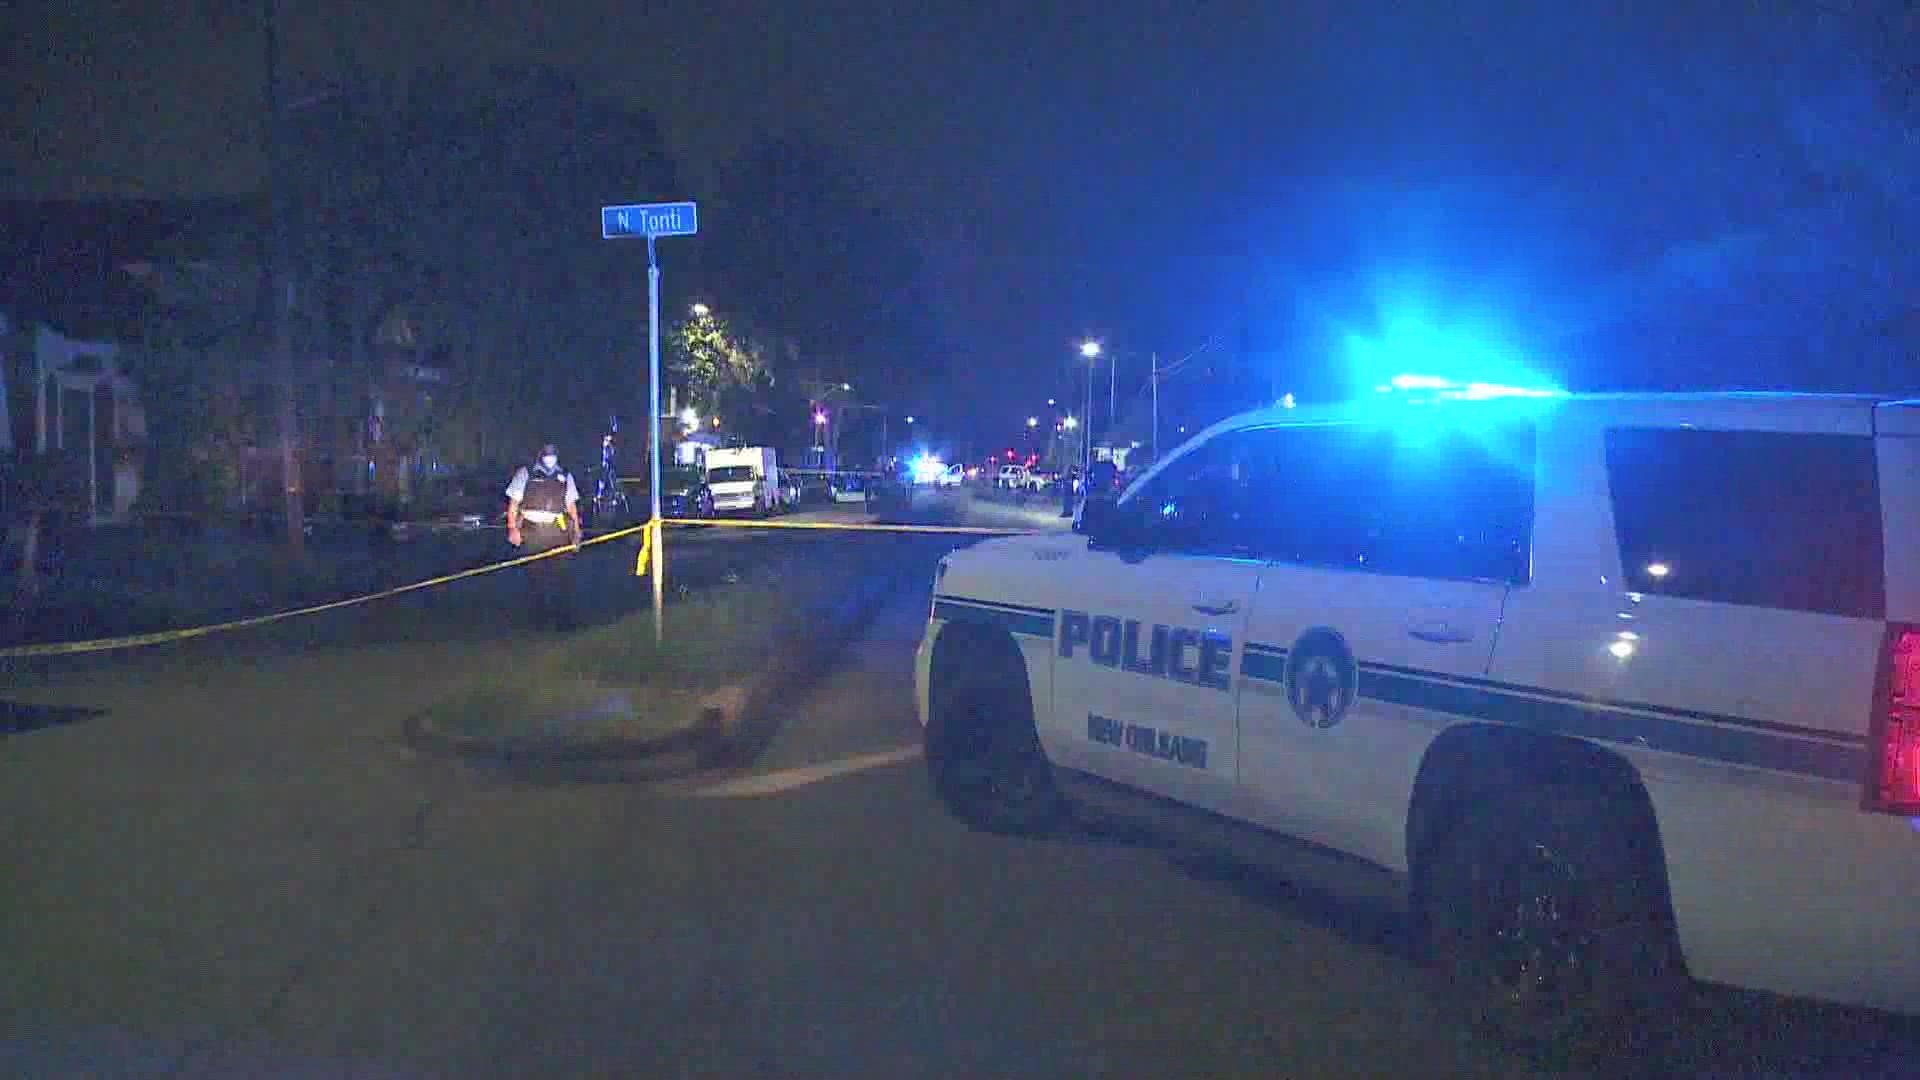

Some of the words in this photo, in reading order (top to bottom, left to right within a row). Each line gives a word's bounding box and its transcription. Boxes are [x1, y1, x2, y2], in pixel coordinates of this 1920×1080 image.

[617, 209, 630, 232] N
[640, 208, 681, 232] Tonti
[1059, 608, 1232, 692] POLICE
